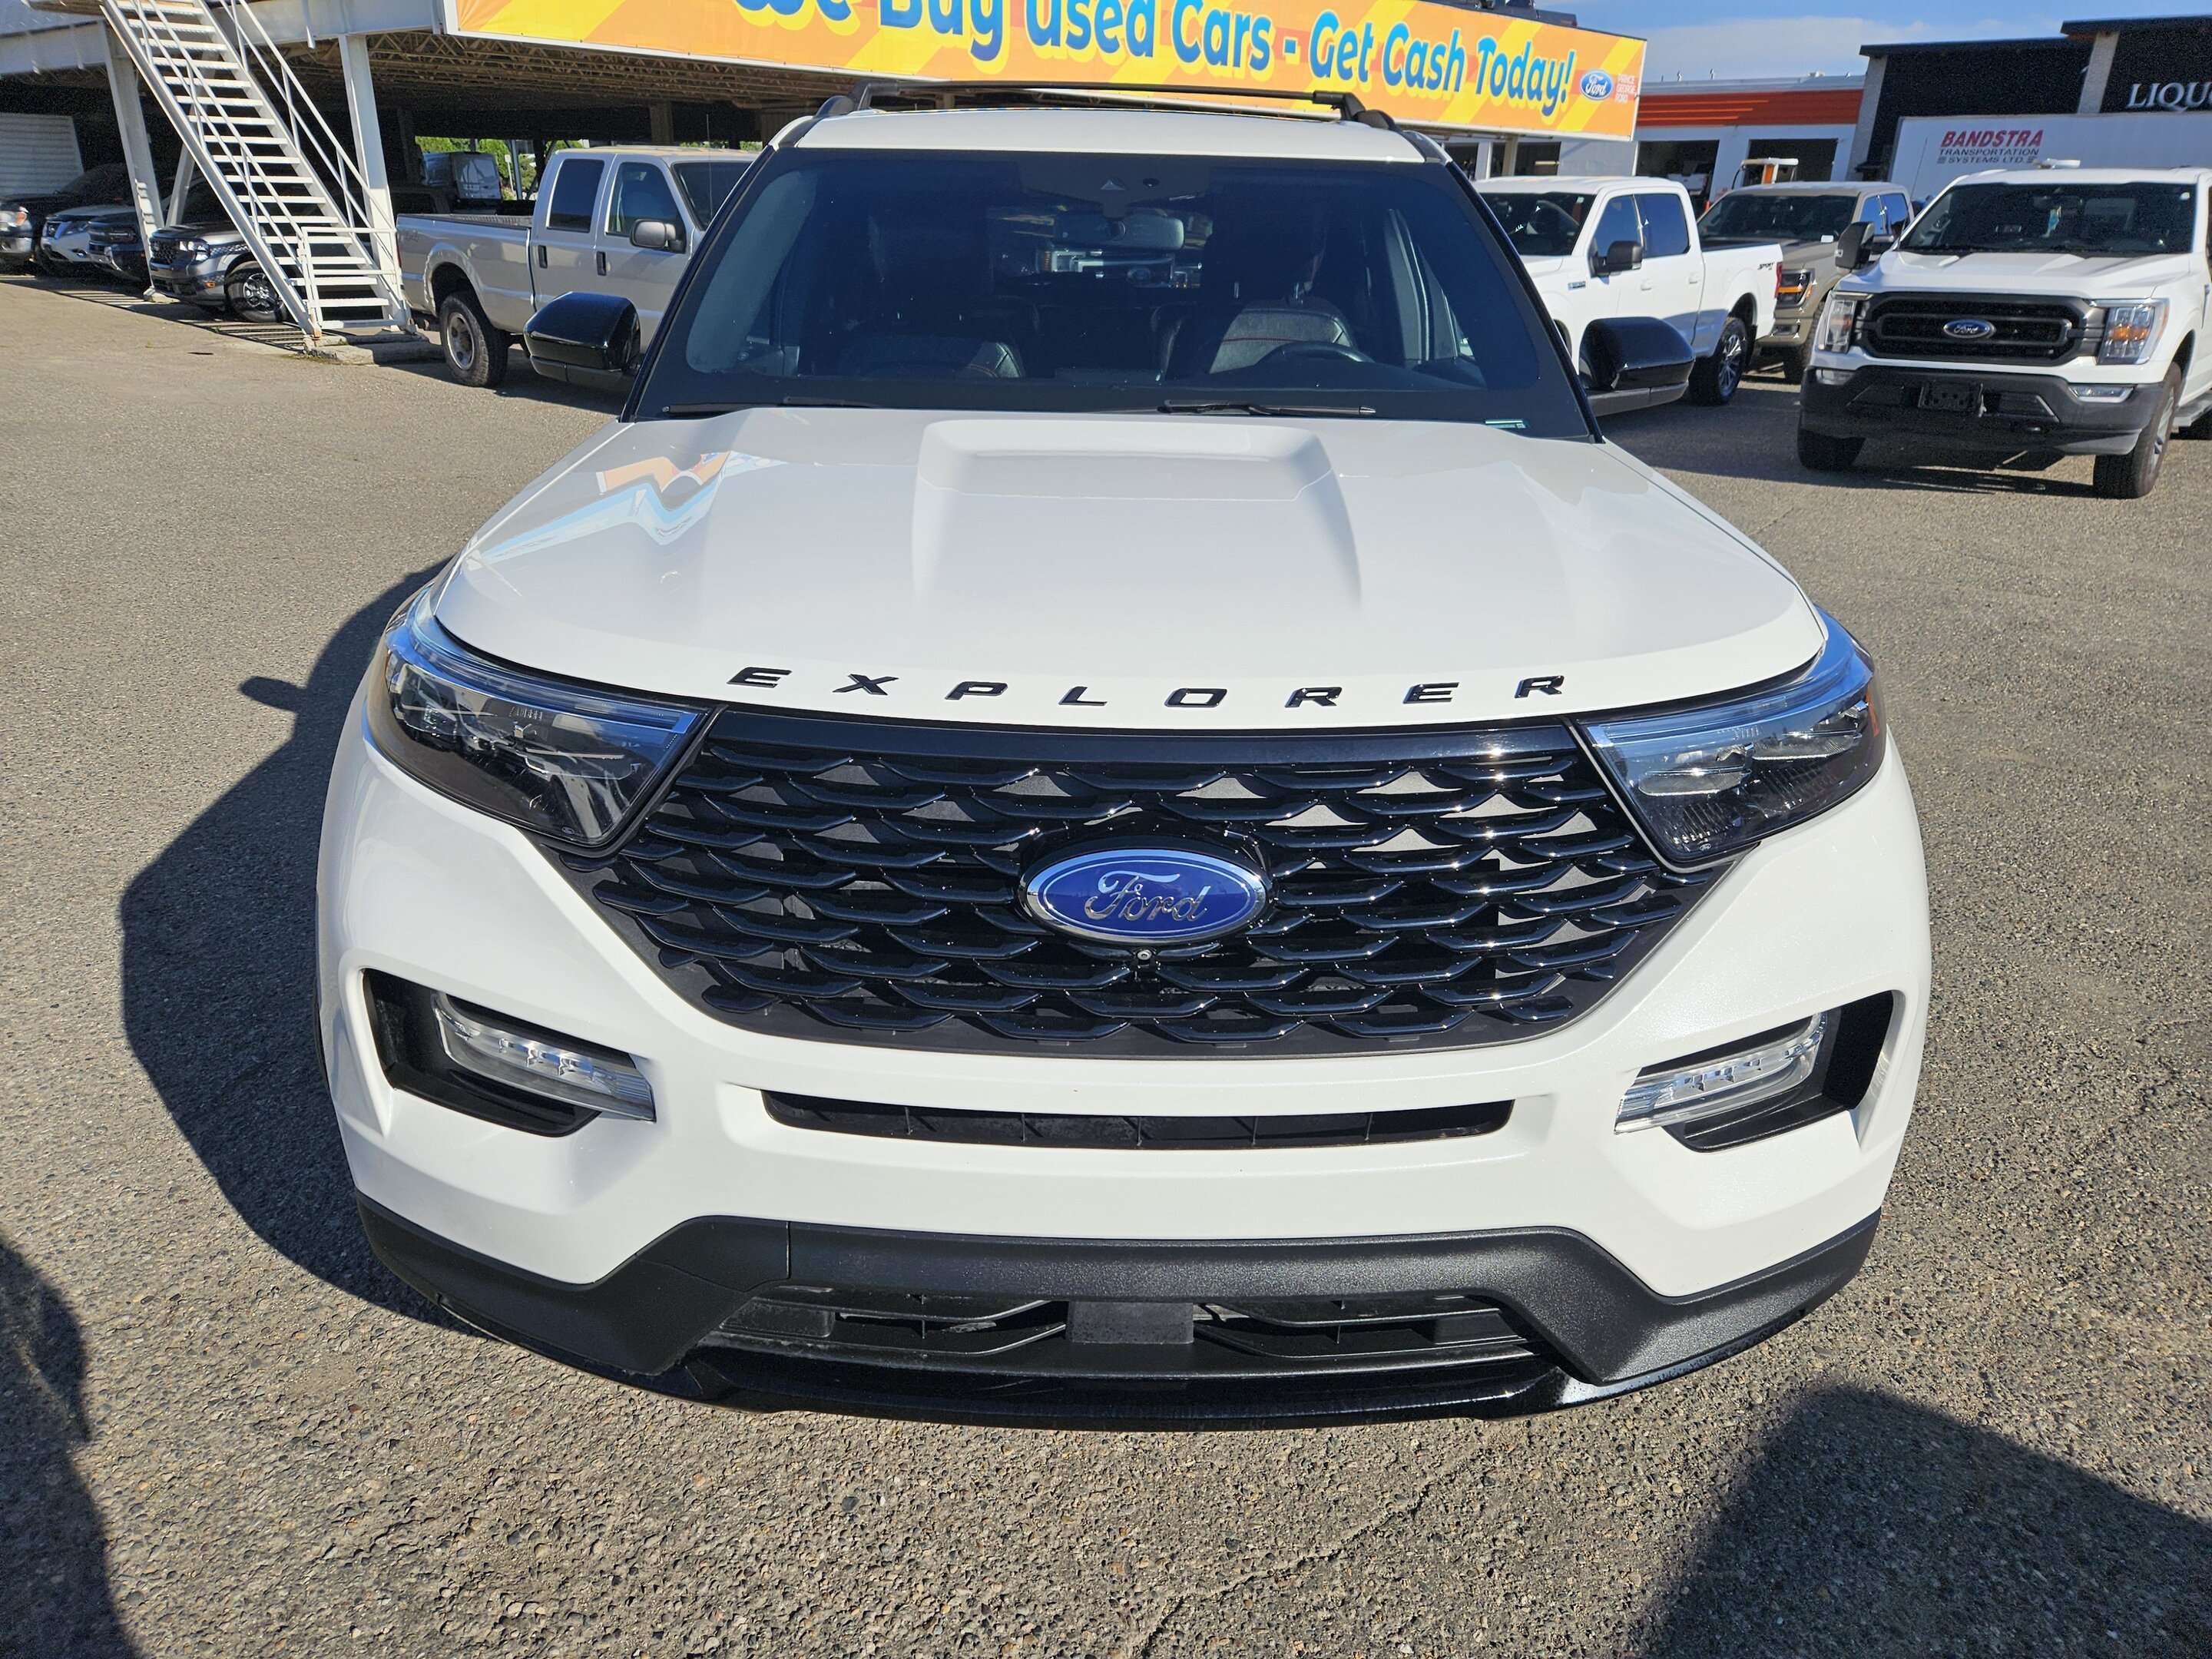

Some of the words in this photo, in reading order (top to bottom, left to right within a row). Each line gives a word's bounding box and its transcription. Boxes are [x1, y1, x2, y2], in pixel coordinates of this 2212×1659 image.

[1171, 0, 1272, 71] Cars
[1309, 11, 1374, 81] Get
[1382, 23, 1465, 92] Cash
[1475, 37, 1575, 117] Today!
[1584, 74, 1608, 96] Ford
[2125, 81, 2212, 111] LIQU
[1941, 129, 2044, 147] BANDSTRA
[1939, 147, 2040, 157] TRANSPORTATION
[1953, 323, 1979, 334] Ford
[727, 666, 1565, 708] EXPLORER
[1084, 869, 1211, 922] Ford
